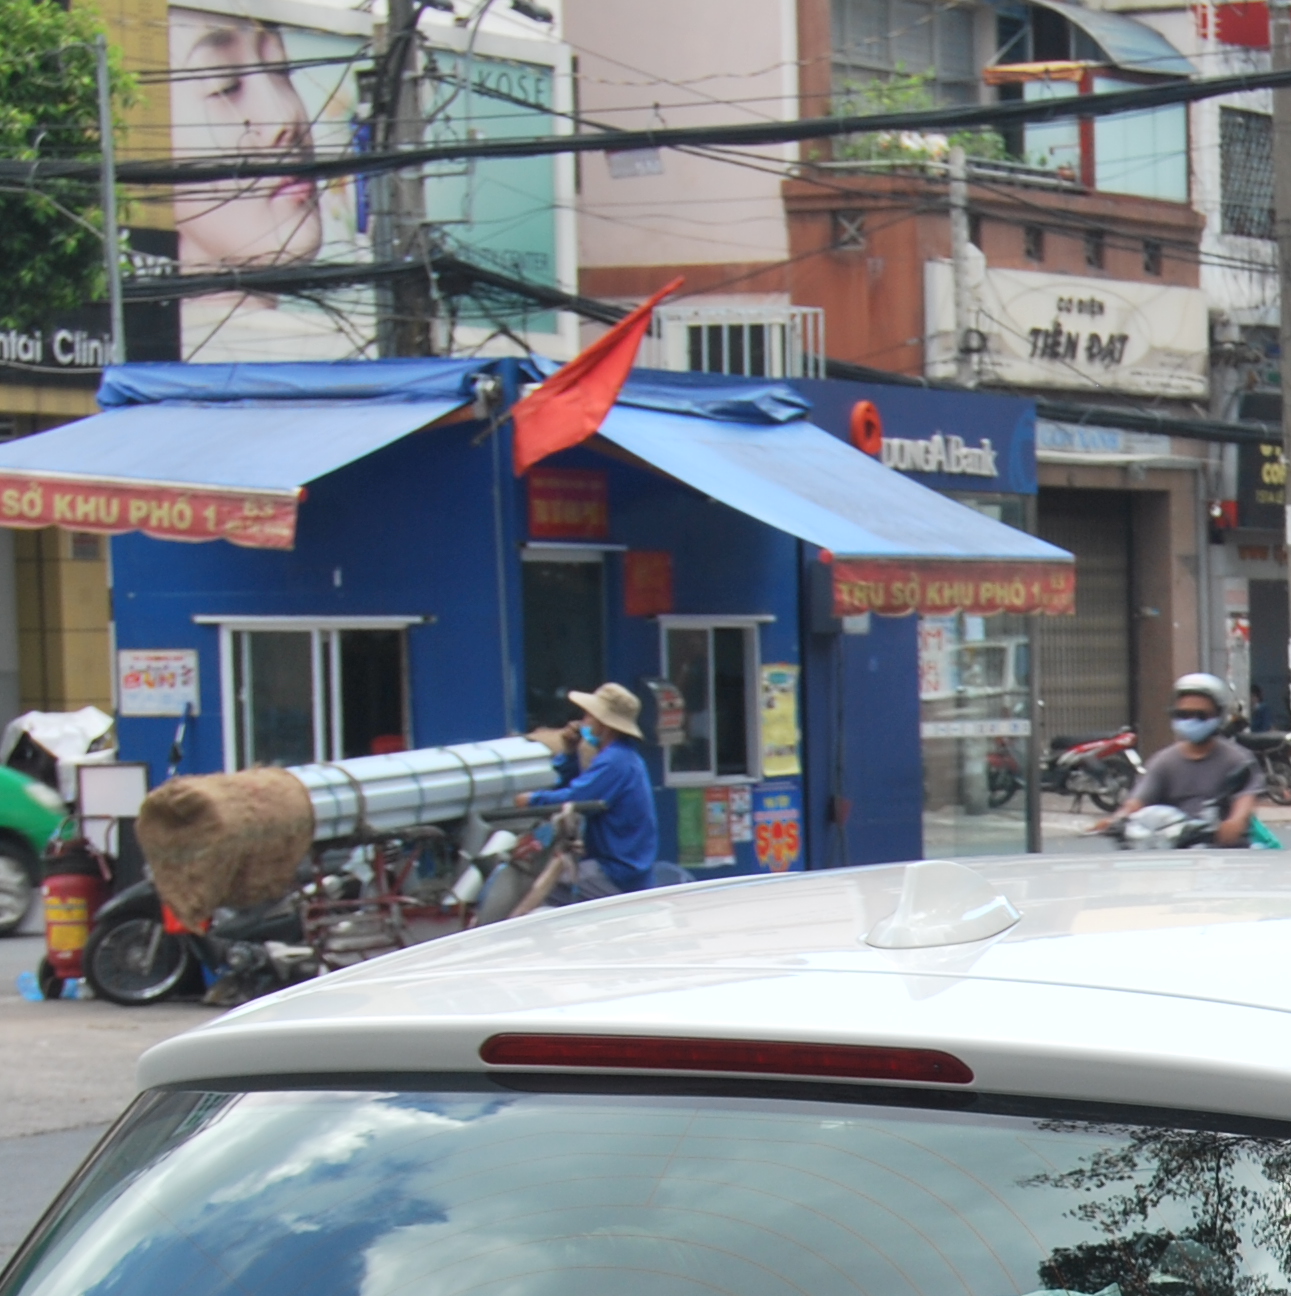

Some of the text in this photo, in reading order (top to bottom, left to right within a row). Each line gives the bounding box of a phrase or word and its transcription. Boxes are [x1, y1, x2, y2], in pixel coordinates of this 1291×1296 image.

[53, 329, 116, 366] Clini
[53, 493, 120, 525] KHU
[129, 491, 193, 531] PHỐ
[203, 505, 217, 531] 1
[926, 582, 974, 606] KHU
